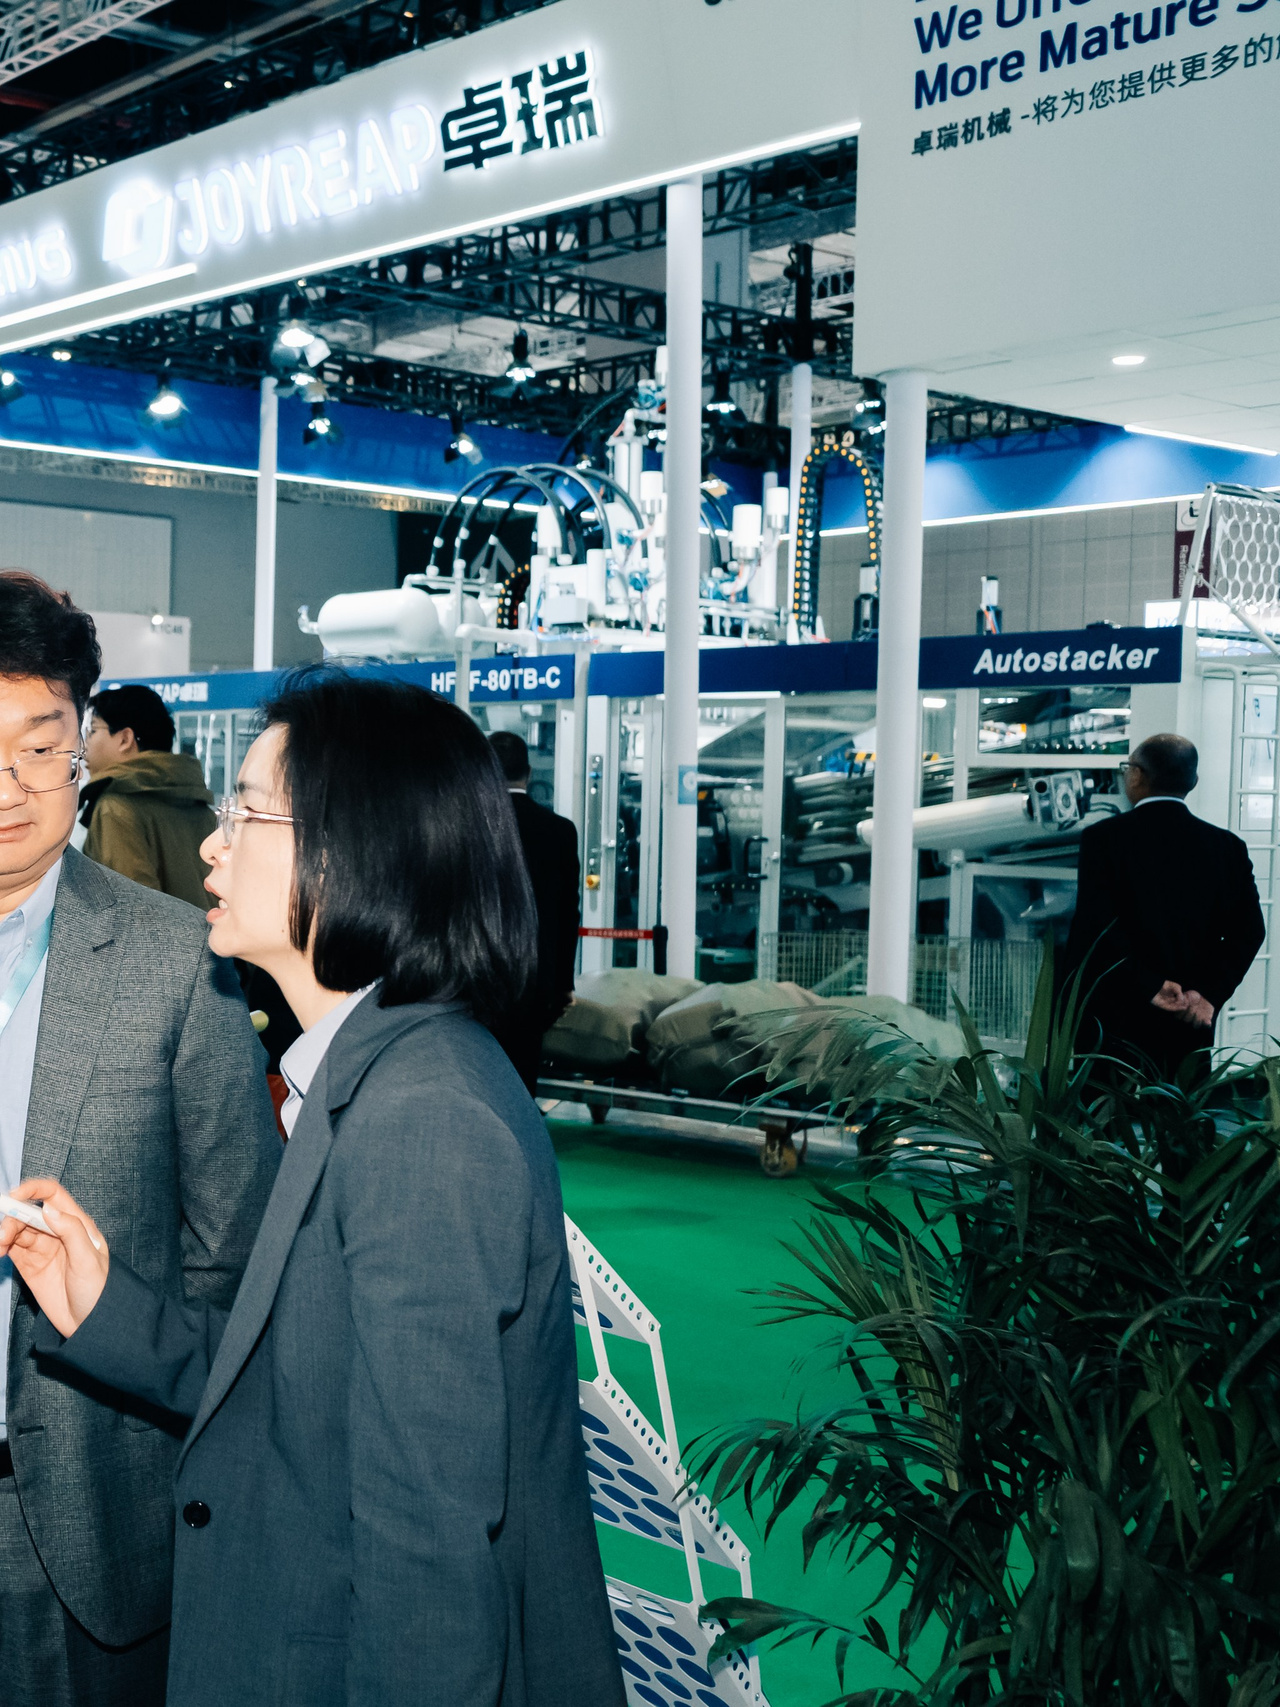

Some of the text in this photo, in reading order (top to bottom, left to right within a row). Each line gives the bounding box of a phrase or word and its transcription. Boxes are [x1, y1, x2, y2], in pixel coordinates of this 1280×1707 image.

[914, 5, 982, 54] We
[915, 0, 1220, 109] More Mature
[911, 32, 1280, 156] 卓瑞机械 -将为您提供更多的
[173, 47, 604, 256] JOYREAP 卓瑞
[431, 665, 561, 693] HFF-80TB-C
[973, 643, 1160, 675] Autostacker
